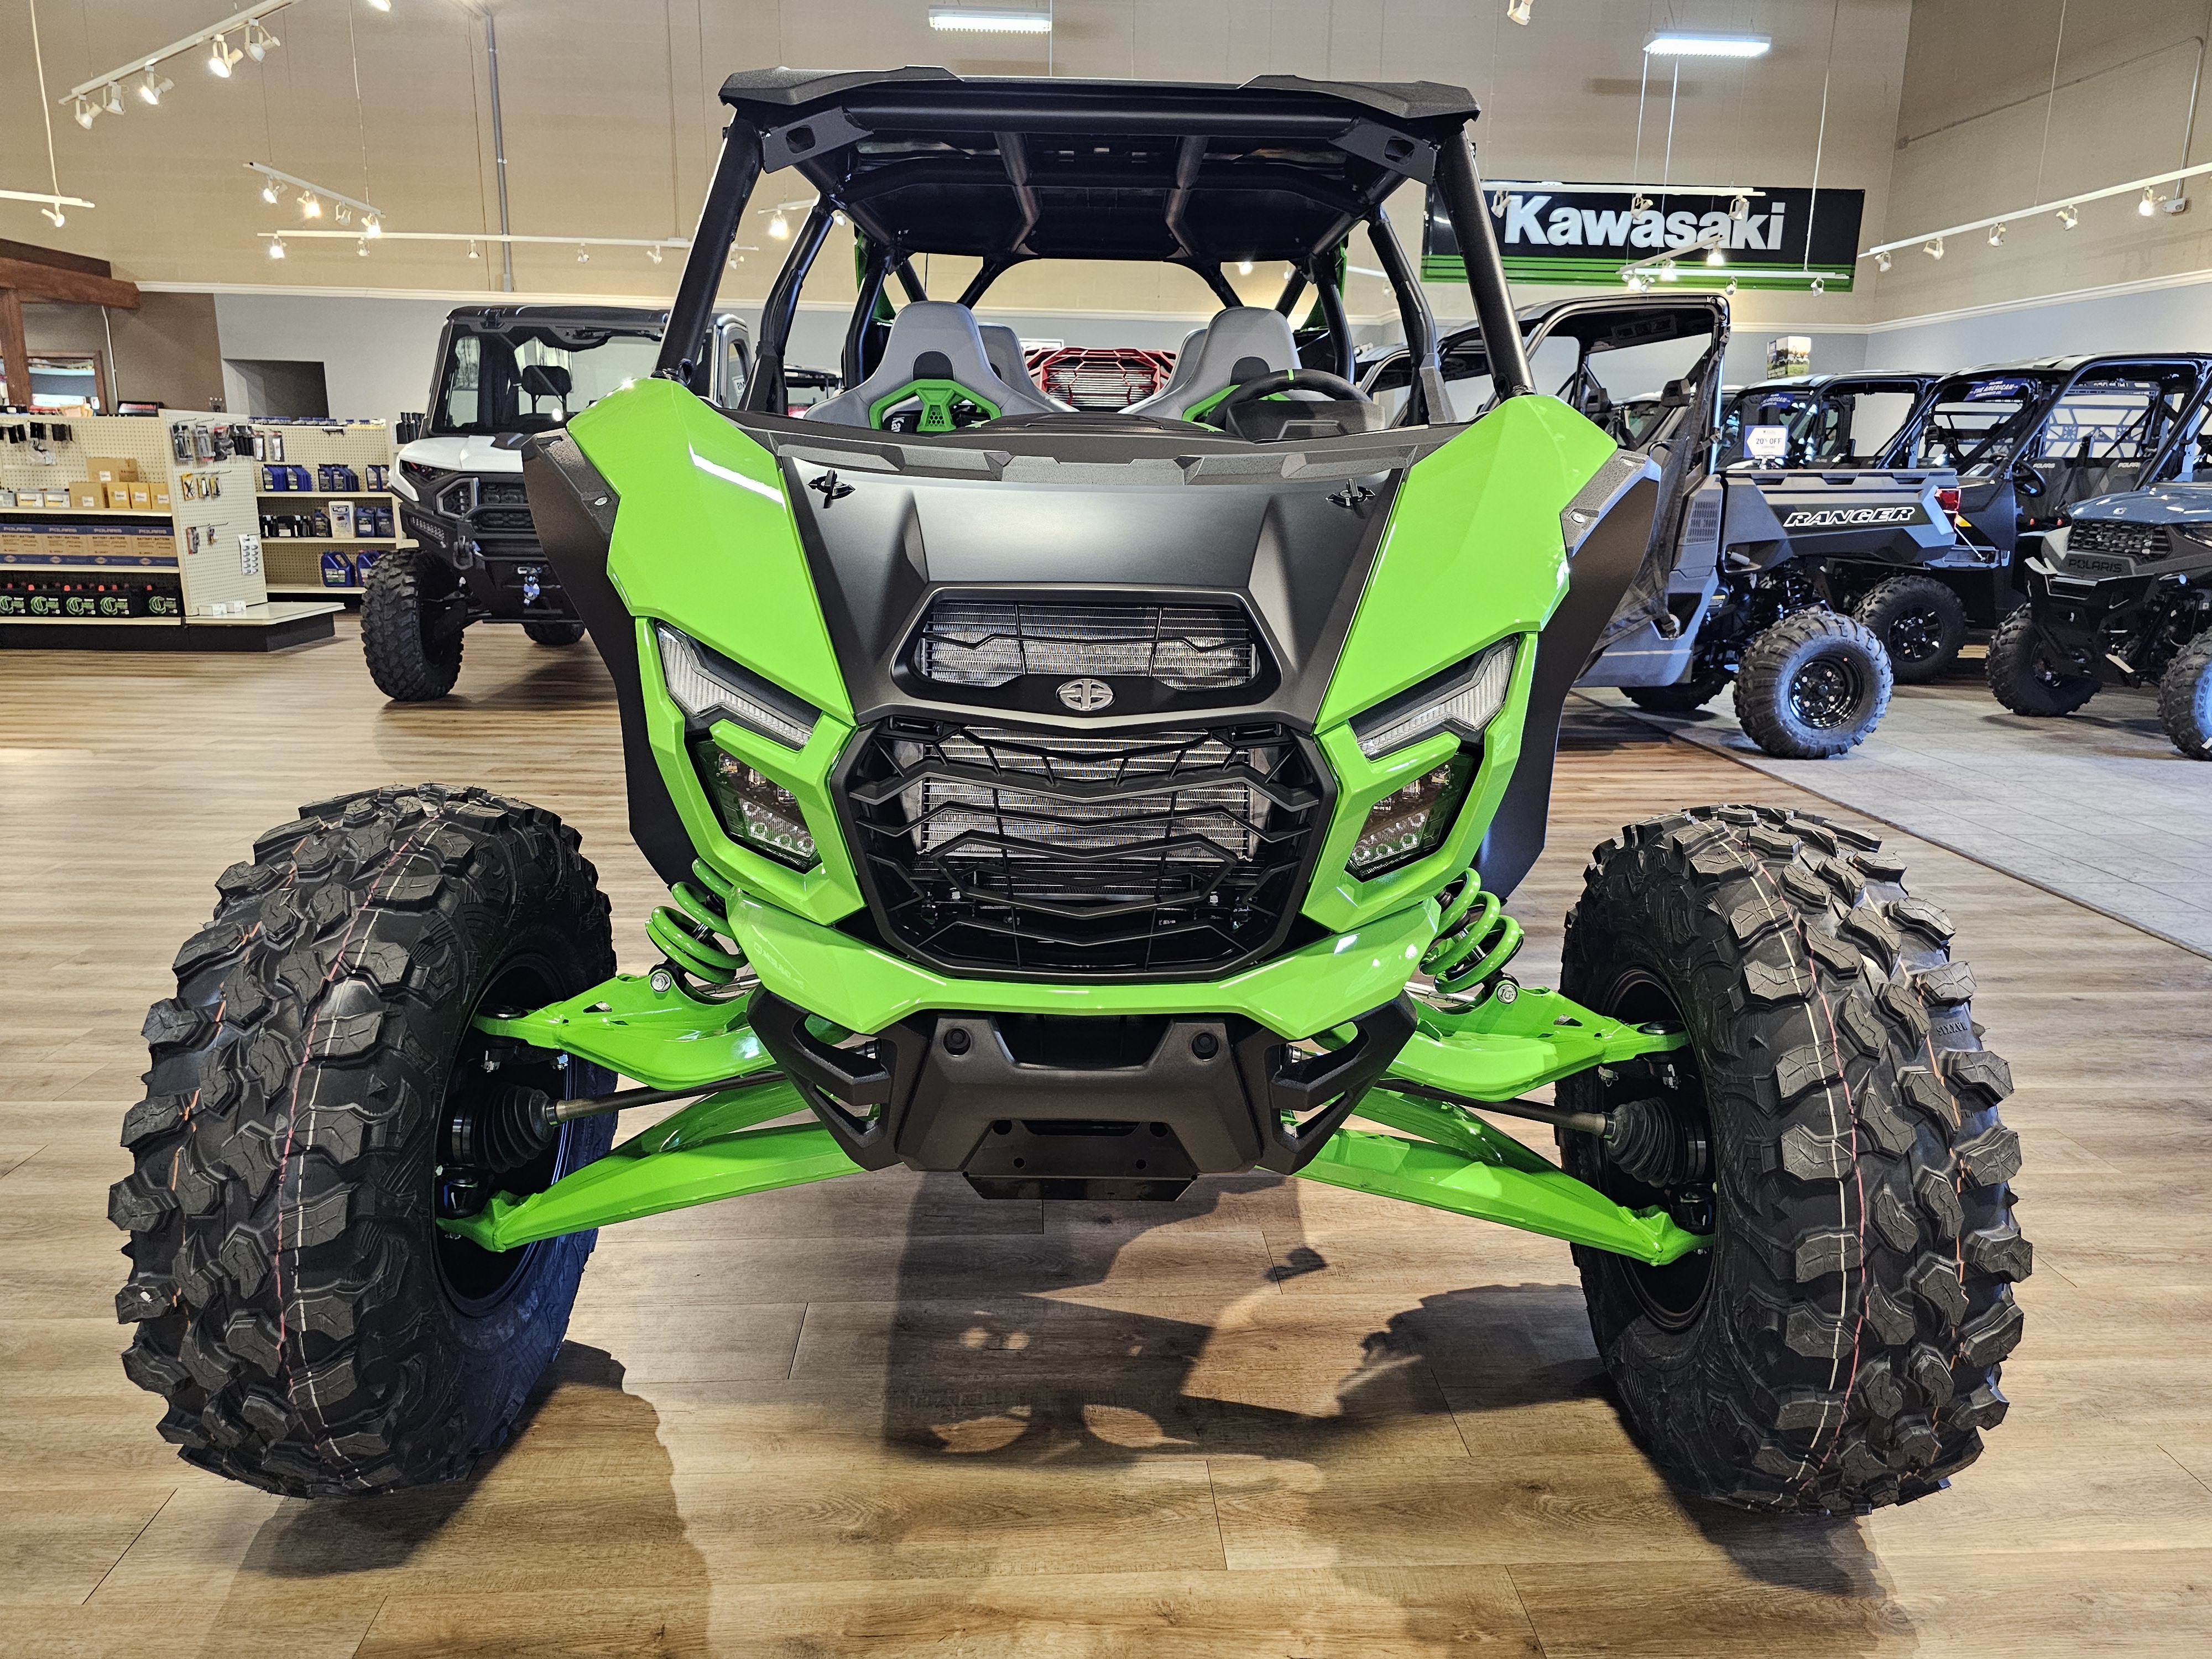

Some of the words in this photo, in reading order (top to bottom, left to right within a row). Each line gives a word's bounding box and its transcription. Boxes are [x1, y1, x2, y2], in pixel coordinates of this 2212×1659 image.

[1504, 195, 1786, 250] Kawasaki
[1983, 384, 2014, 392] AMERICAN
[1782, 507, 1916, 527] RANGER
[2068, 559, 2122, 573] POLARIS
[1936, 1021, 1968, 1036] MAXXIS
